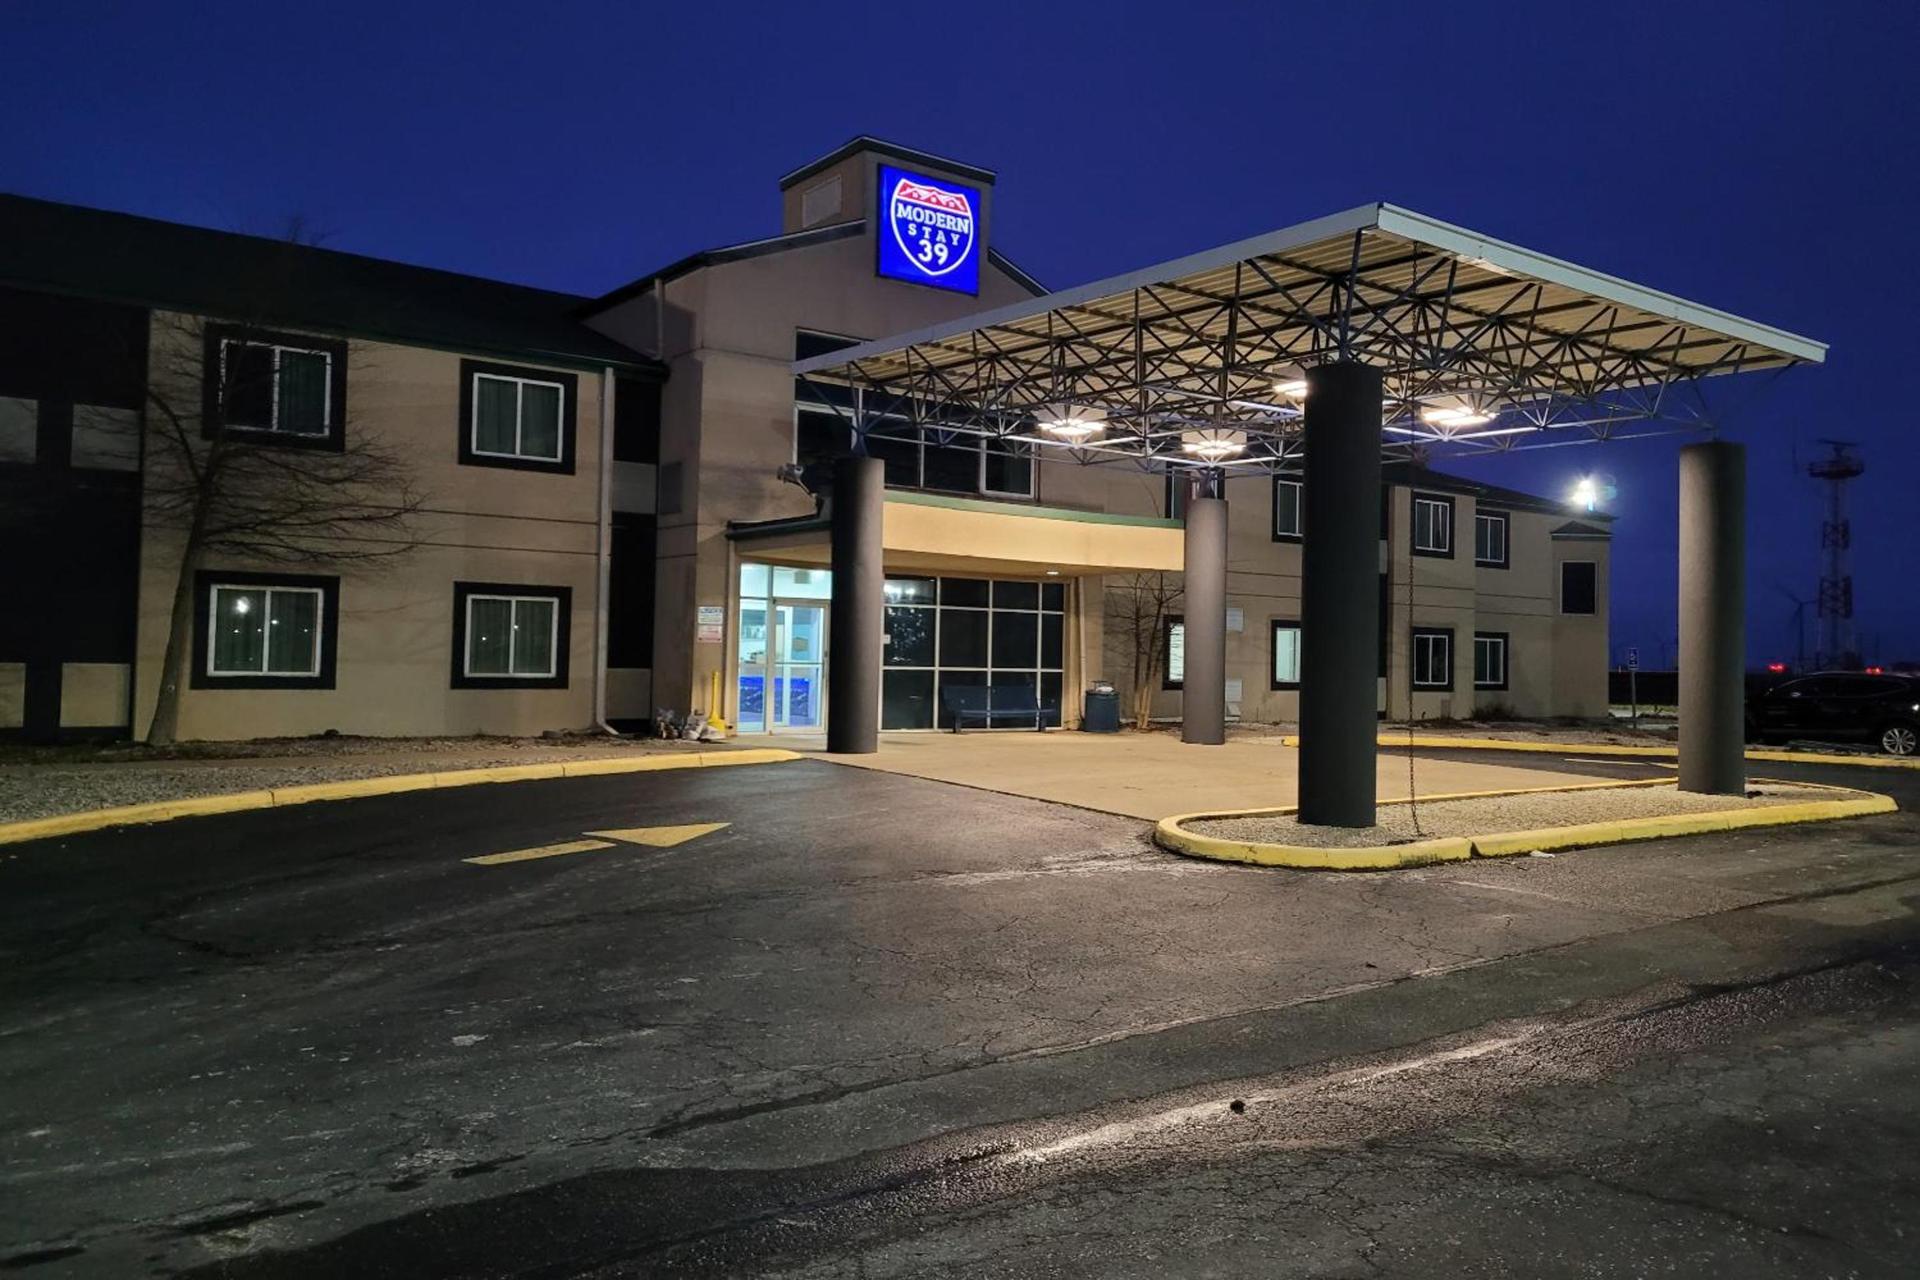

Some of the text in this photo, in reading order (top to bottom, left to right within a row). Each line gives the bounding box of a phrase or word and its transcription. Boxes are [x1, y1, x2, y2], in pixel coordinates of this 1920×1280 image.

[897, 202, 969, 234] MODERN
[908, 223, 960, 246] STAY
[918, 239, 948, 265] 39
